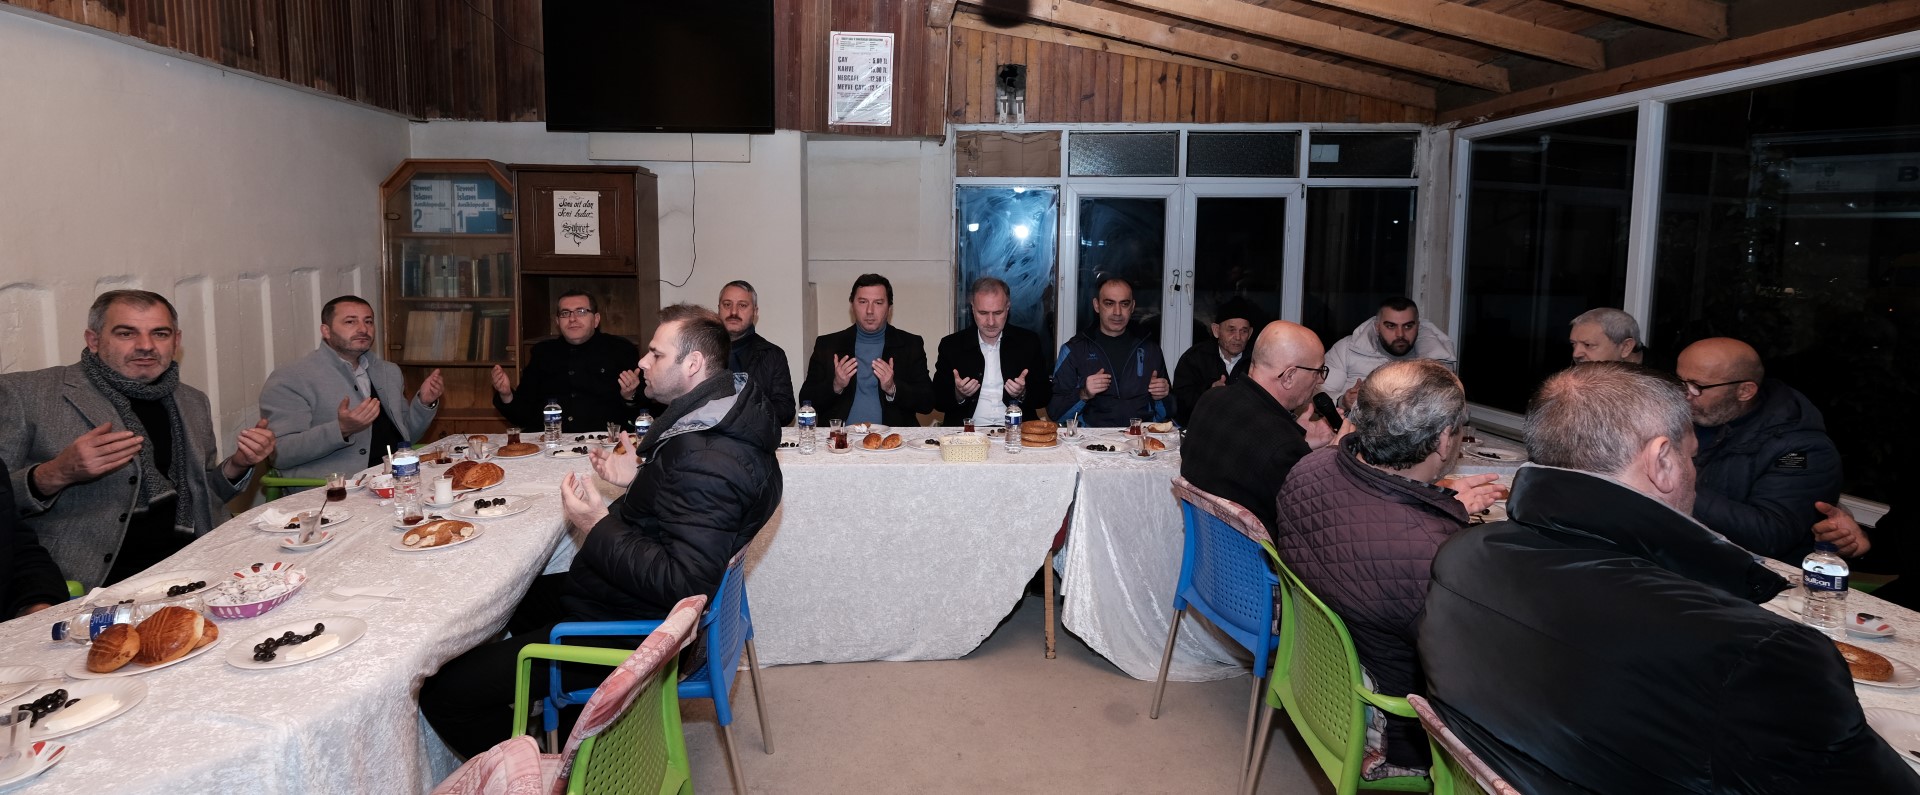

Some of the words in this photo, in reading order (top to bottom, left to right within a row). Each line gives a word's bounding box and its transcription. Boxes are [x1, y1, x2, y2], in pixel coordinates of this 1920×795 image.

[414, 209, 422, 228] 2
[457, 210, 463, 229] 1
[1804, 575, 1830, 586] Sultan
